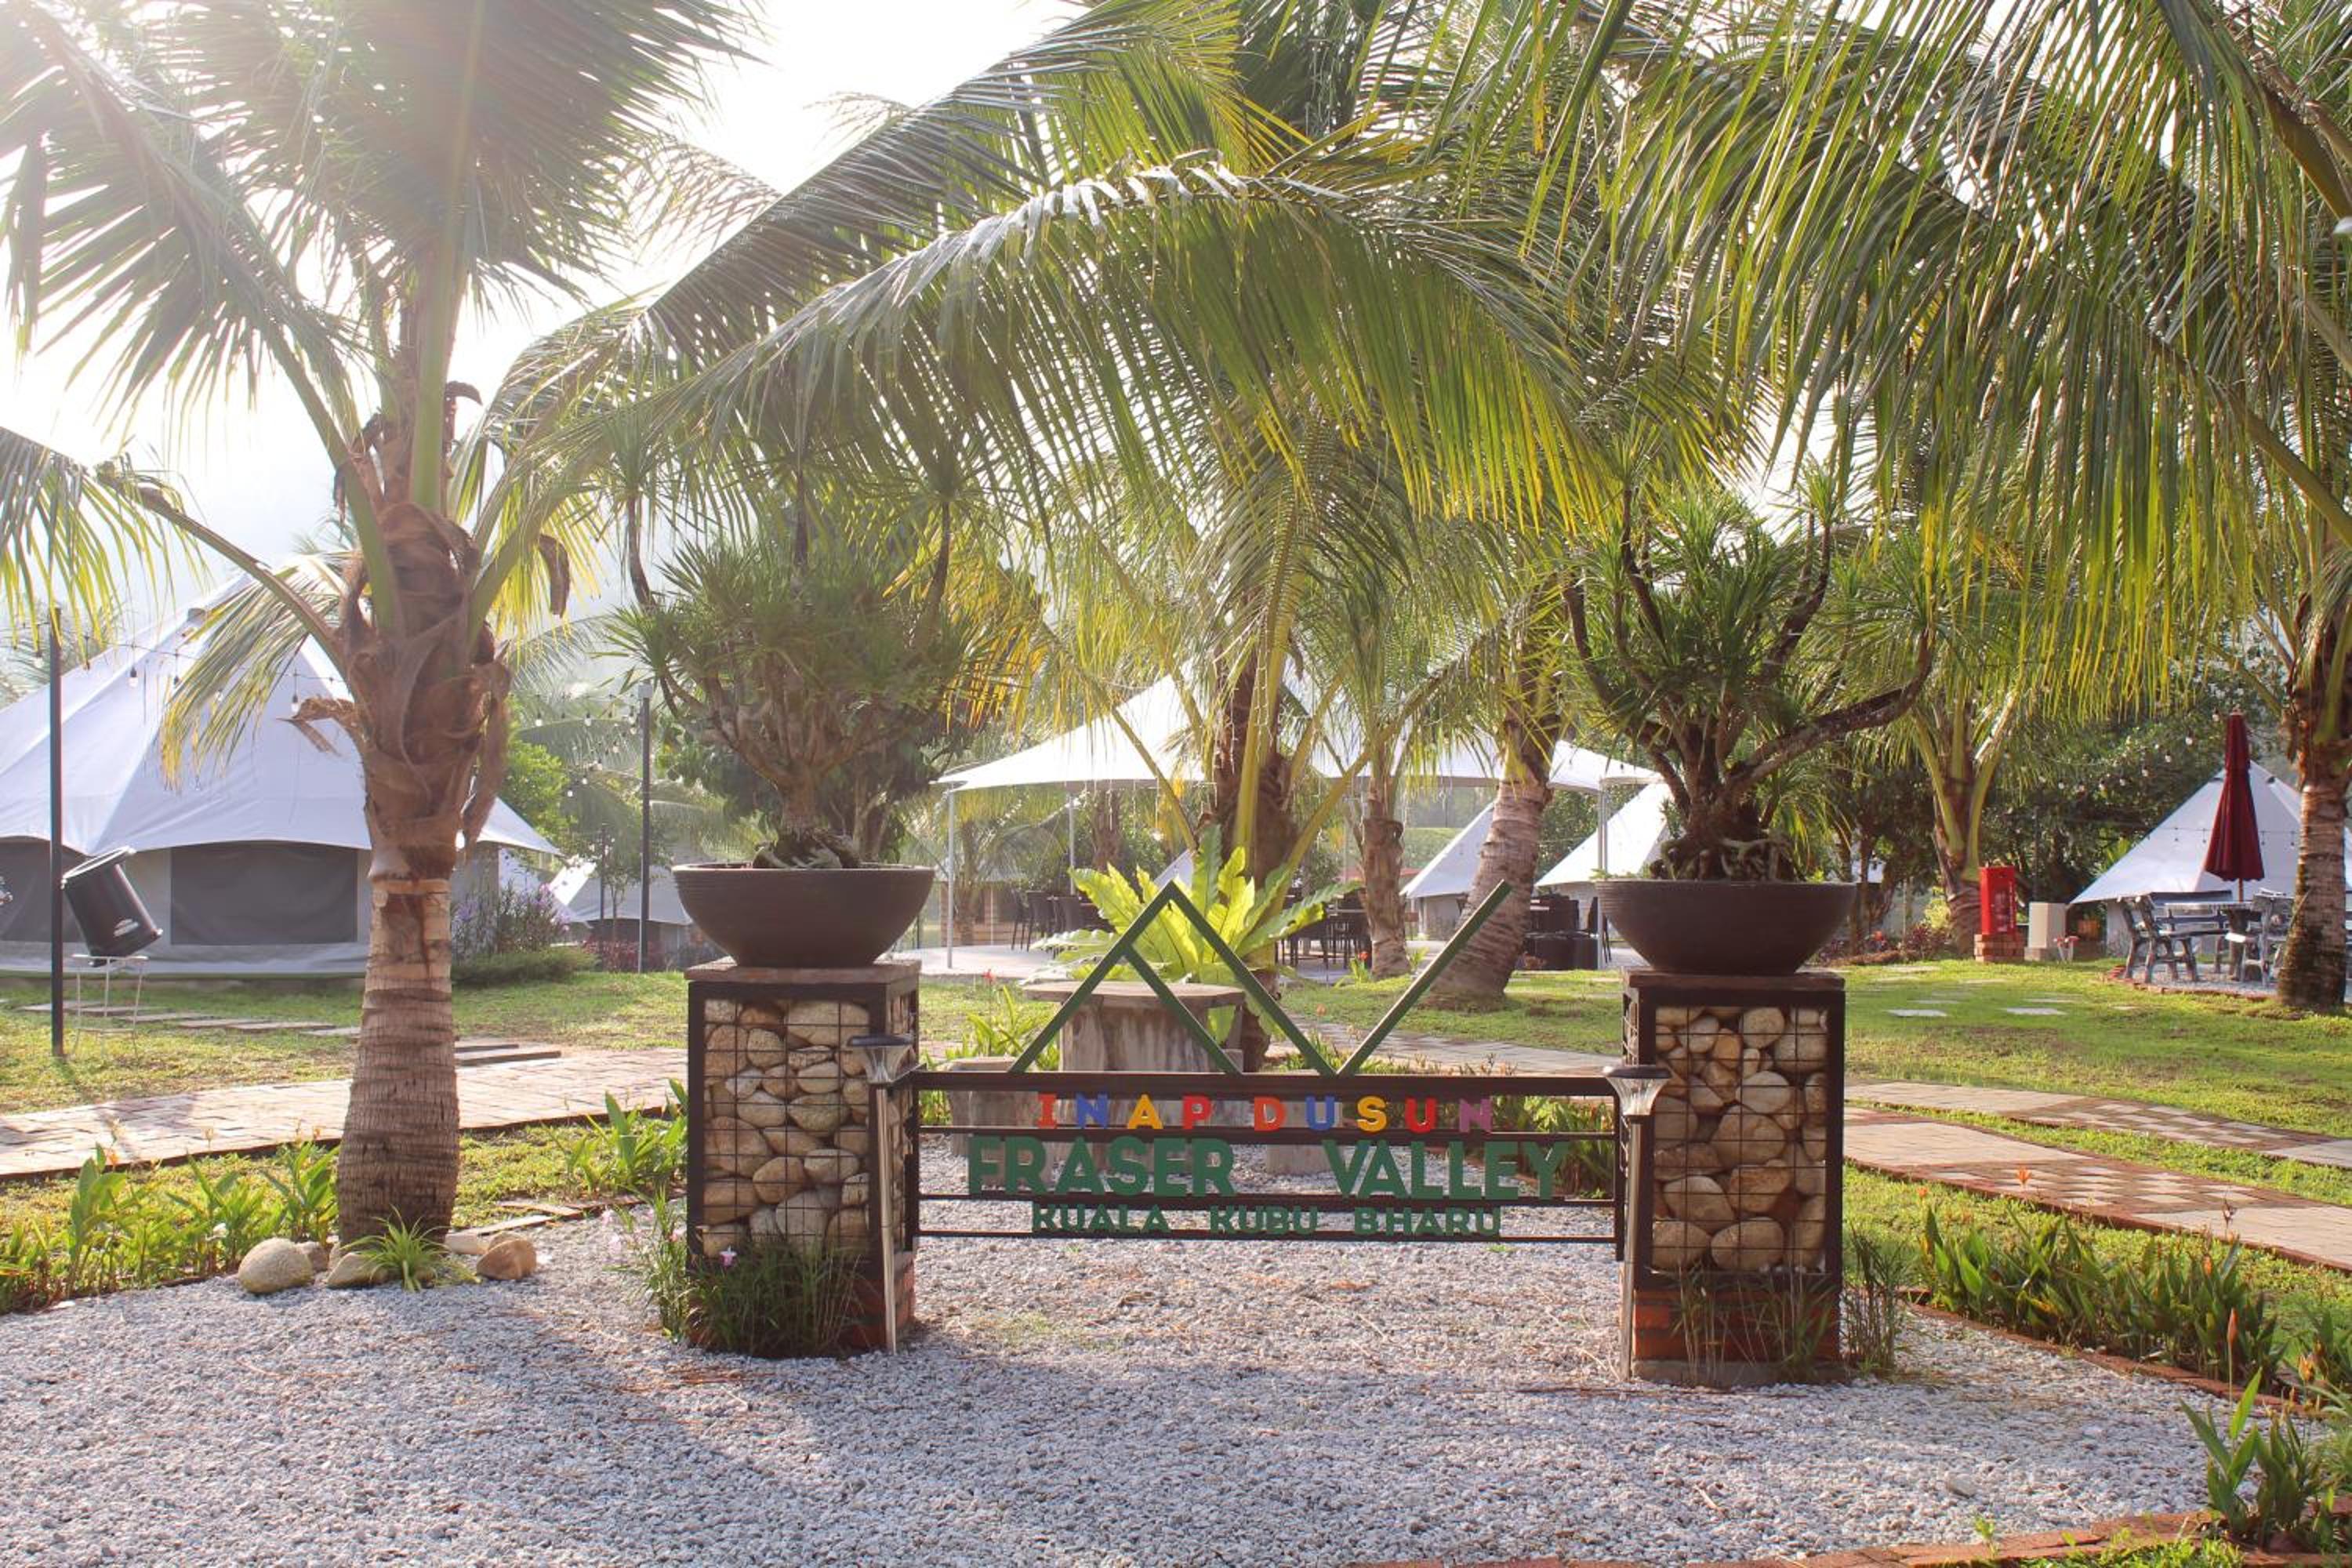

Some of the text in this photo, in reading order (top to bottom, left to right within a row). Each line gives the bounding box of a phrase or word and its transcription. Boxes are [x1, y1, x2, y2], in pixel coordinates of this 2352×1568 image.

[1037, 1094, 1493, 1134] INAP DUSUN
[967, 1135, 1570, 1201] FRASER VALLEY
[1033, 1203, 1501, 1236] KUALA KUBU BHARU
